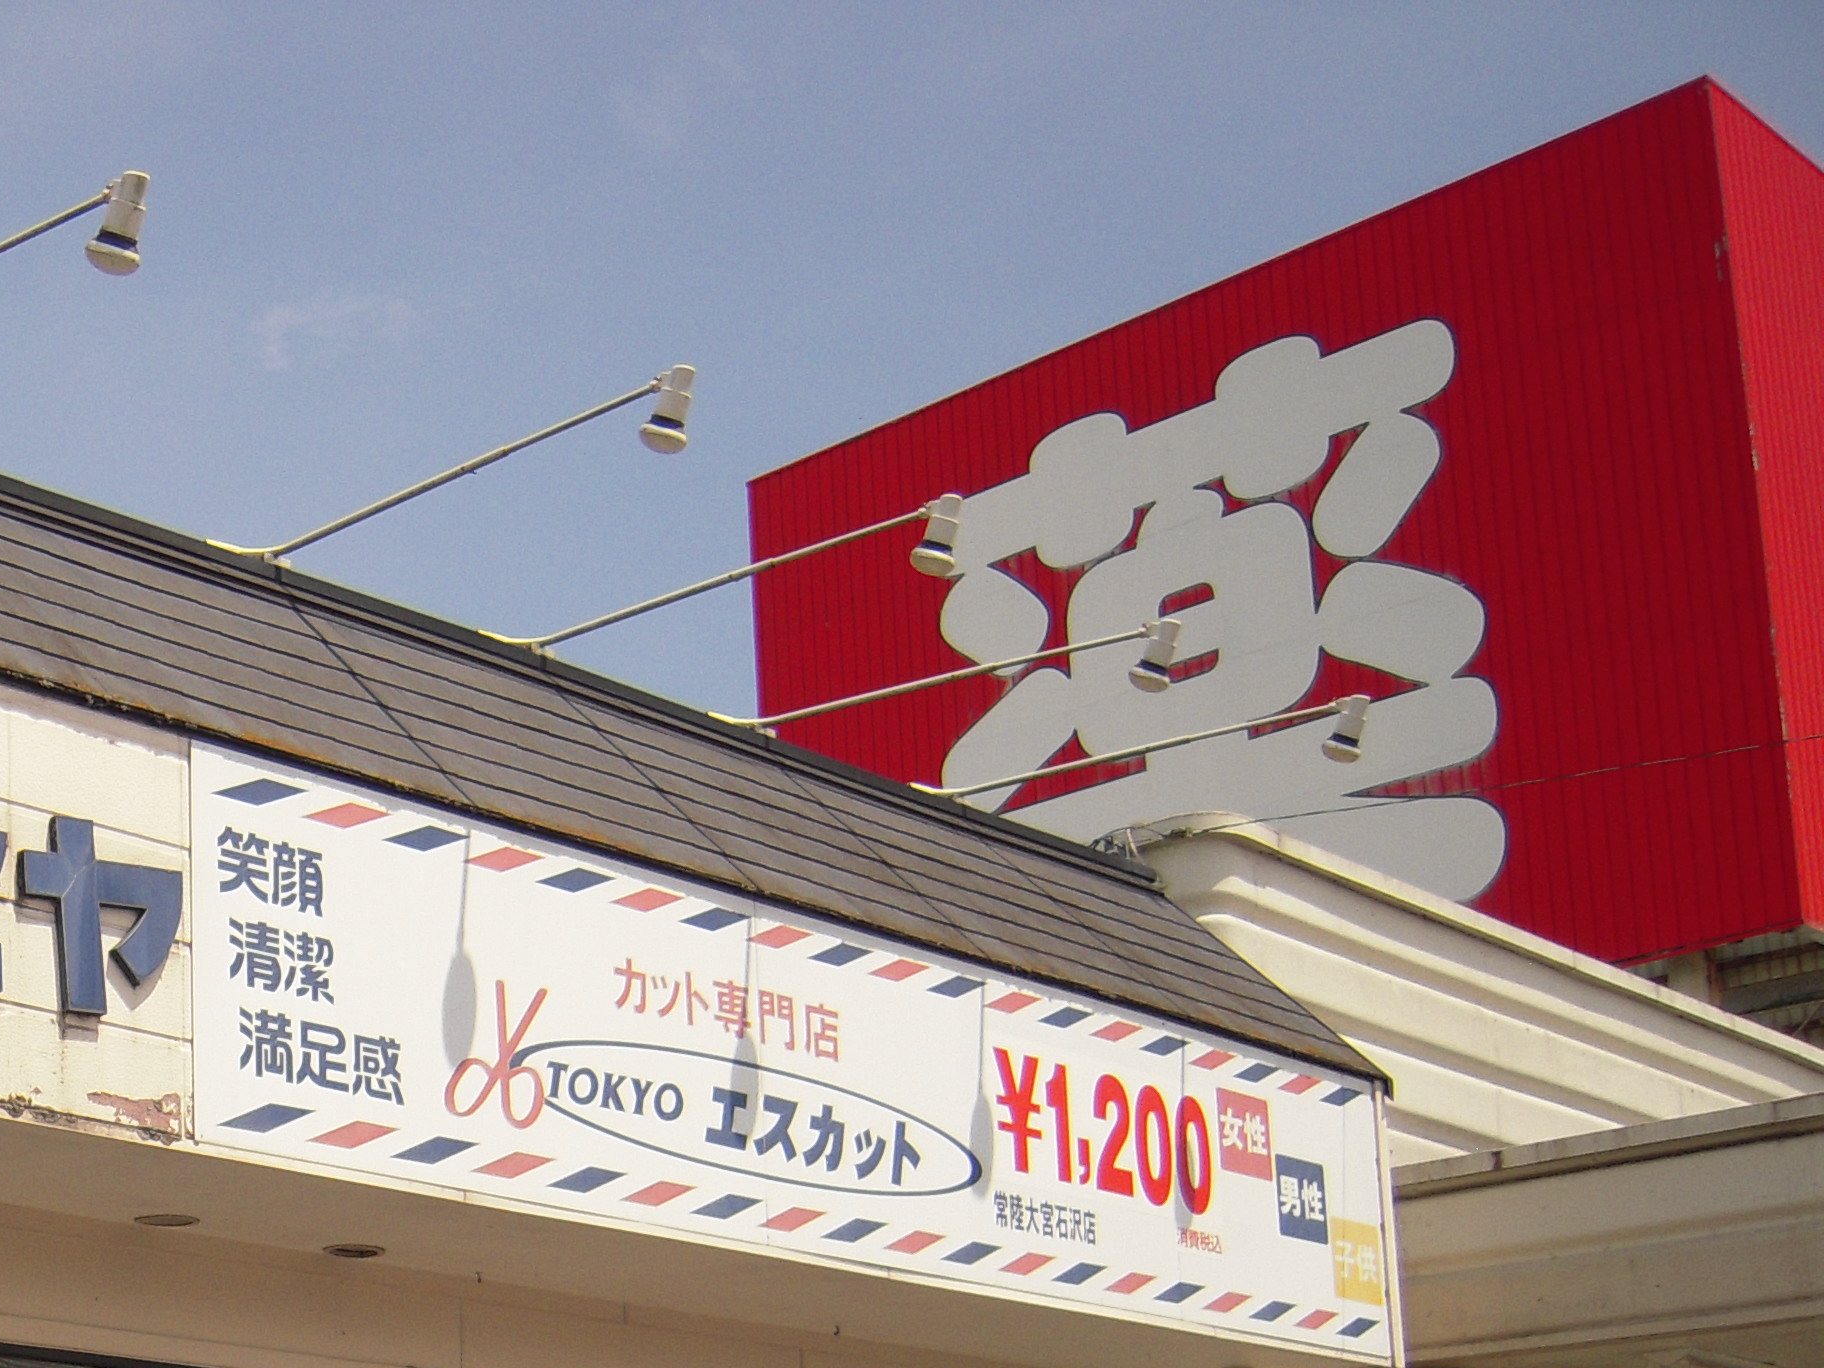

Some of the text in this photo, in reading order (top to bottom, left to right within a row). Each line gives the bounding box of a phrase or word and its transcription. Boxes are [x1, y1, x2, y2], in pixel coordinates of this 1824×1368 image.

[940, 318, 1506, 904] 薬
[217, 826, 324, 918] 笑顔
[229, 916, 335, 1005] 清潔
[239, 1006, 405, 1106] 満足感
[613, 957, 841, 1063] カット専門店
[547, 1060, 922, 1188] TOKYO エスカット
[992, 1047, 1213, 1216] ¥1,200
[1220, 1107, 1268, 1156] 女性
[993, 1189, 1097, 1246] 常陸大宮石沢店
[1279, 1174, 1325, 1223] 男性
[1336, 1240, 1380, 1283] 子供
